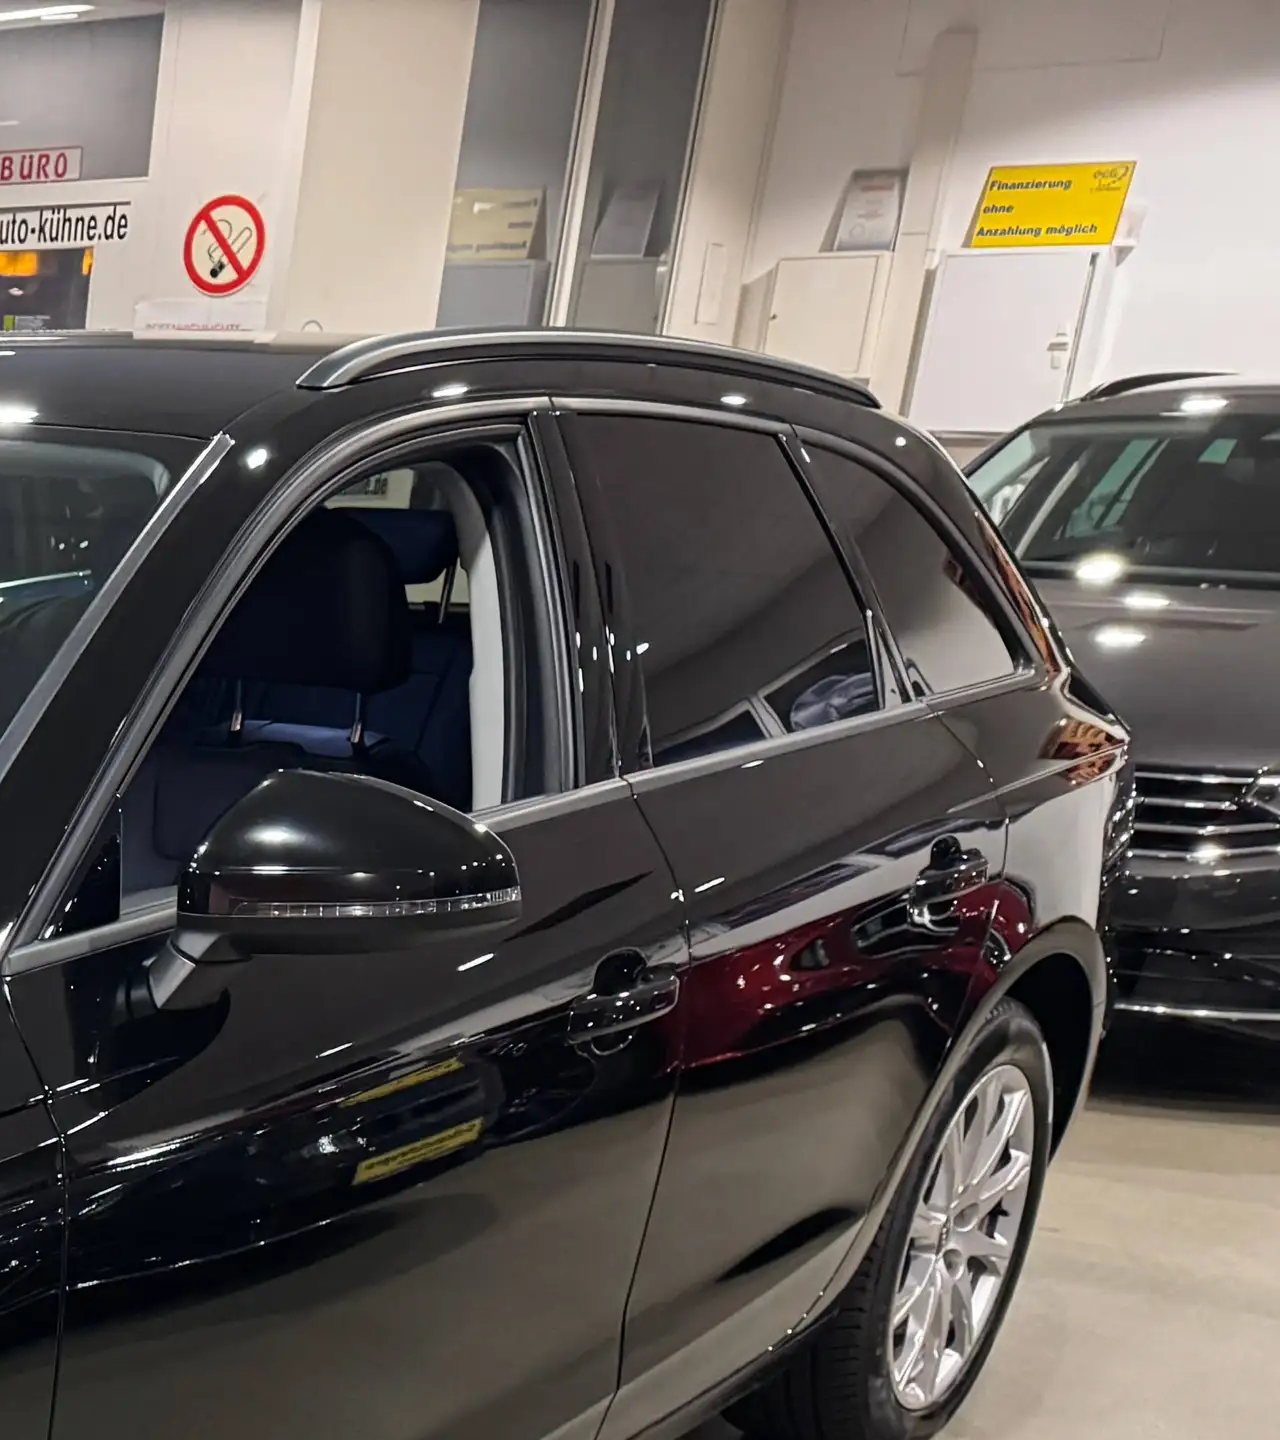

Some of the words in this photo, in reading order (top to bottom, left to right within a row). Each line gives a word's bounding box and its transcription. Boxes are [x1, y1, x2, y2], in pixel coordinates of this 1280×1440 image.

[0, 152, 68, 181] BÜRO
[989, 179, 1072, 191] Finanzierung
[983, 204, 1014, 214] ohne
[976, 226, 1042, 237] Anzahlung
[1045, 224, 1098, 237] möglich
